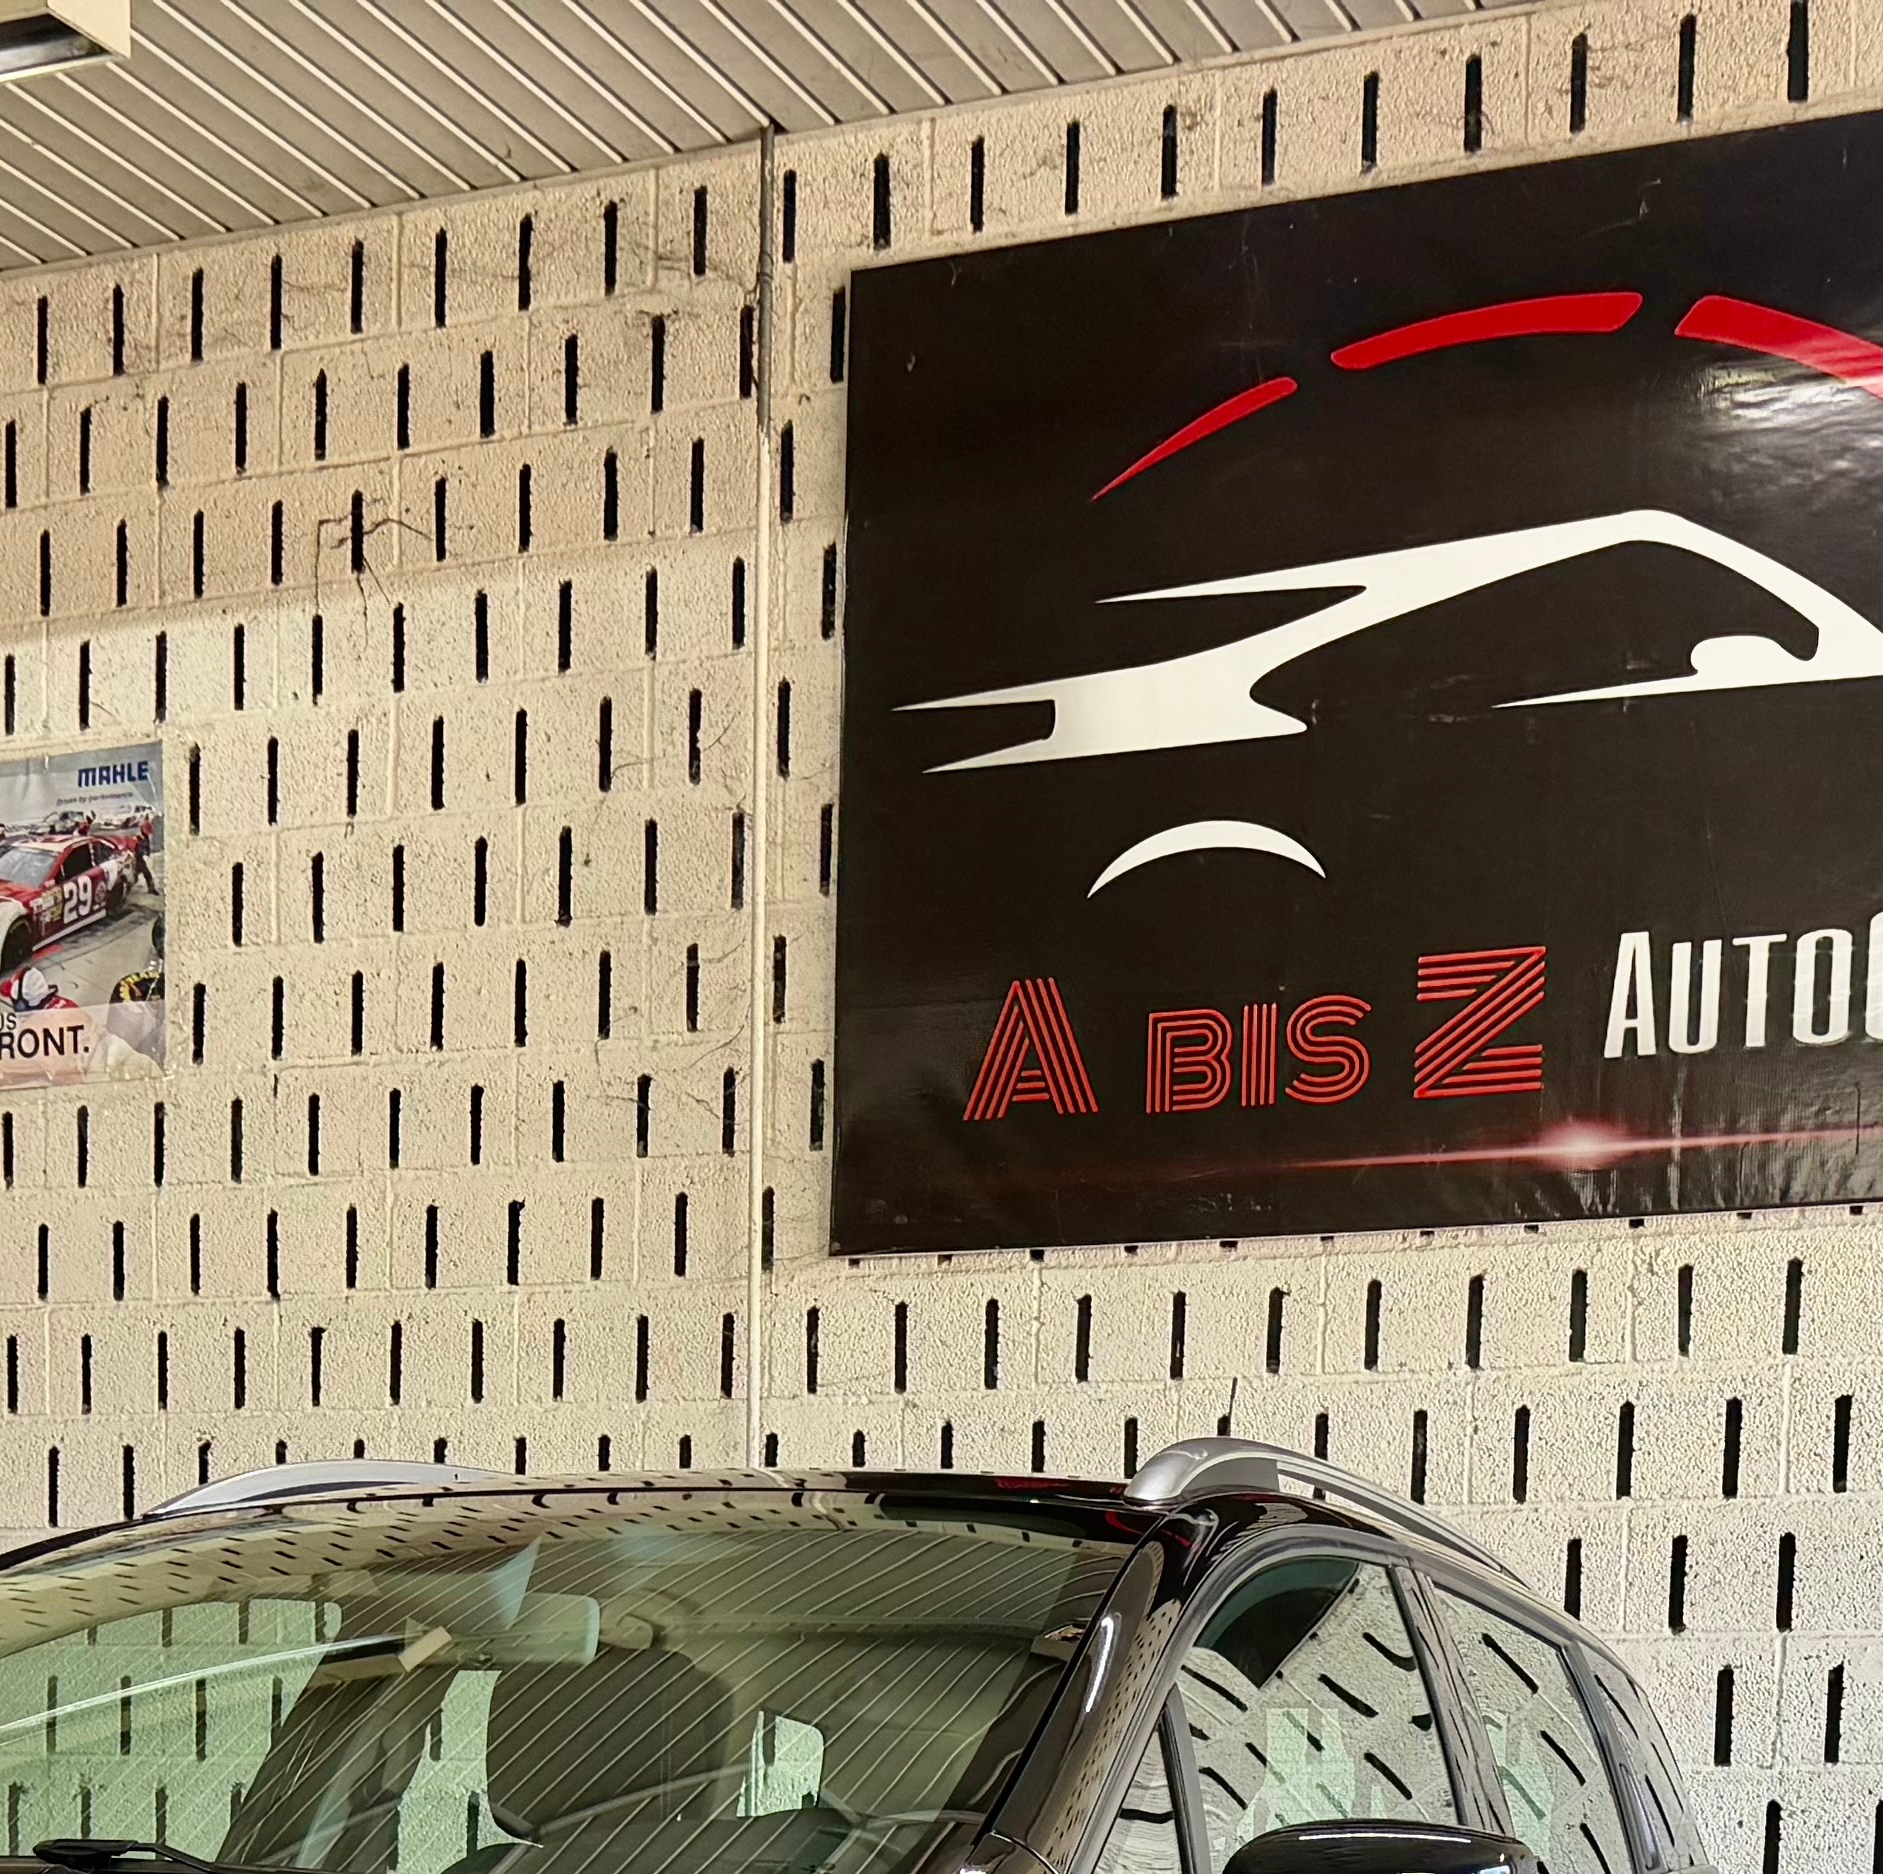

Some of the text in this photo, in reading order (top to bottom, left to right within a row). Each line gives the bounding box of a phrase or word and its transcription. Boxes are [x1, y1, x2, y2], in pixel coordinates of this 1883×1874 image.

[77, 760, 149, 788] MAHLE
[63, 874, 93, 924] 29
[961, 944, 1547, 1122] A BIS Z
